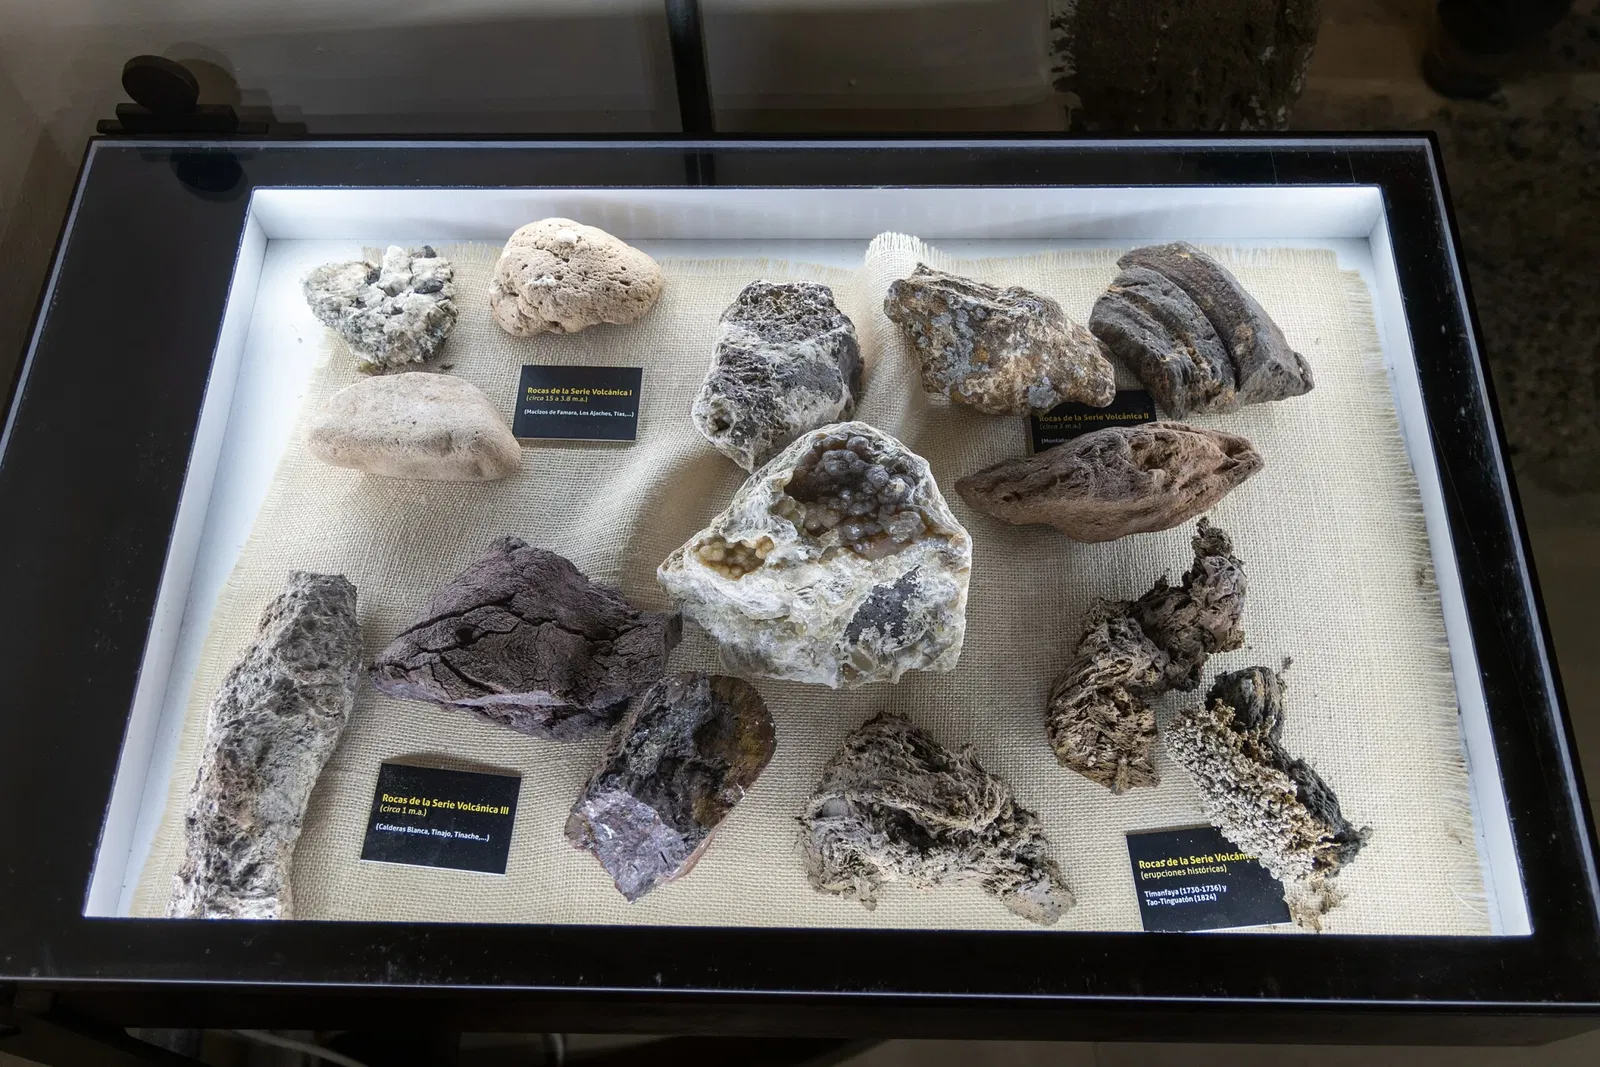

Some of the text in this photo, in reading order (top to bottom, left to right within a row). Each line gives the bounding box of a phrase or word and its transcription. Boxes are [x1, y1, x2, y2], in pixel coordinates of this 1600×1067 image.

[380, 804, 400, 813] (circa
[409, 808, 427, 817] m.a.)
[383, 794, 509, 814] Rocas de la Serie Volcánica III
[376, 823, 406, 832] (Calderas
[407, 826, 429, 835] Blanca,
[432, 829, 452, 838] Tinajo,
[1139, 859, 1165, 869] Rocas
[1168, 858, 1178, 866] de
[1180, 857, 1188, 865] la
[1190, 855, 1213, 864] Serie
[1141, 864, 1227, 880] (erupciones históricas)
[1144, 888, 1179, 897] Timanfaya
[1180, 884, 1221, 895] (1730-1736)
[1146, 894, 1216, 906] Tao-Tinguatón (1824)
